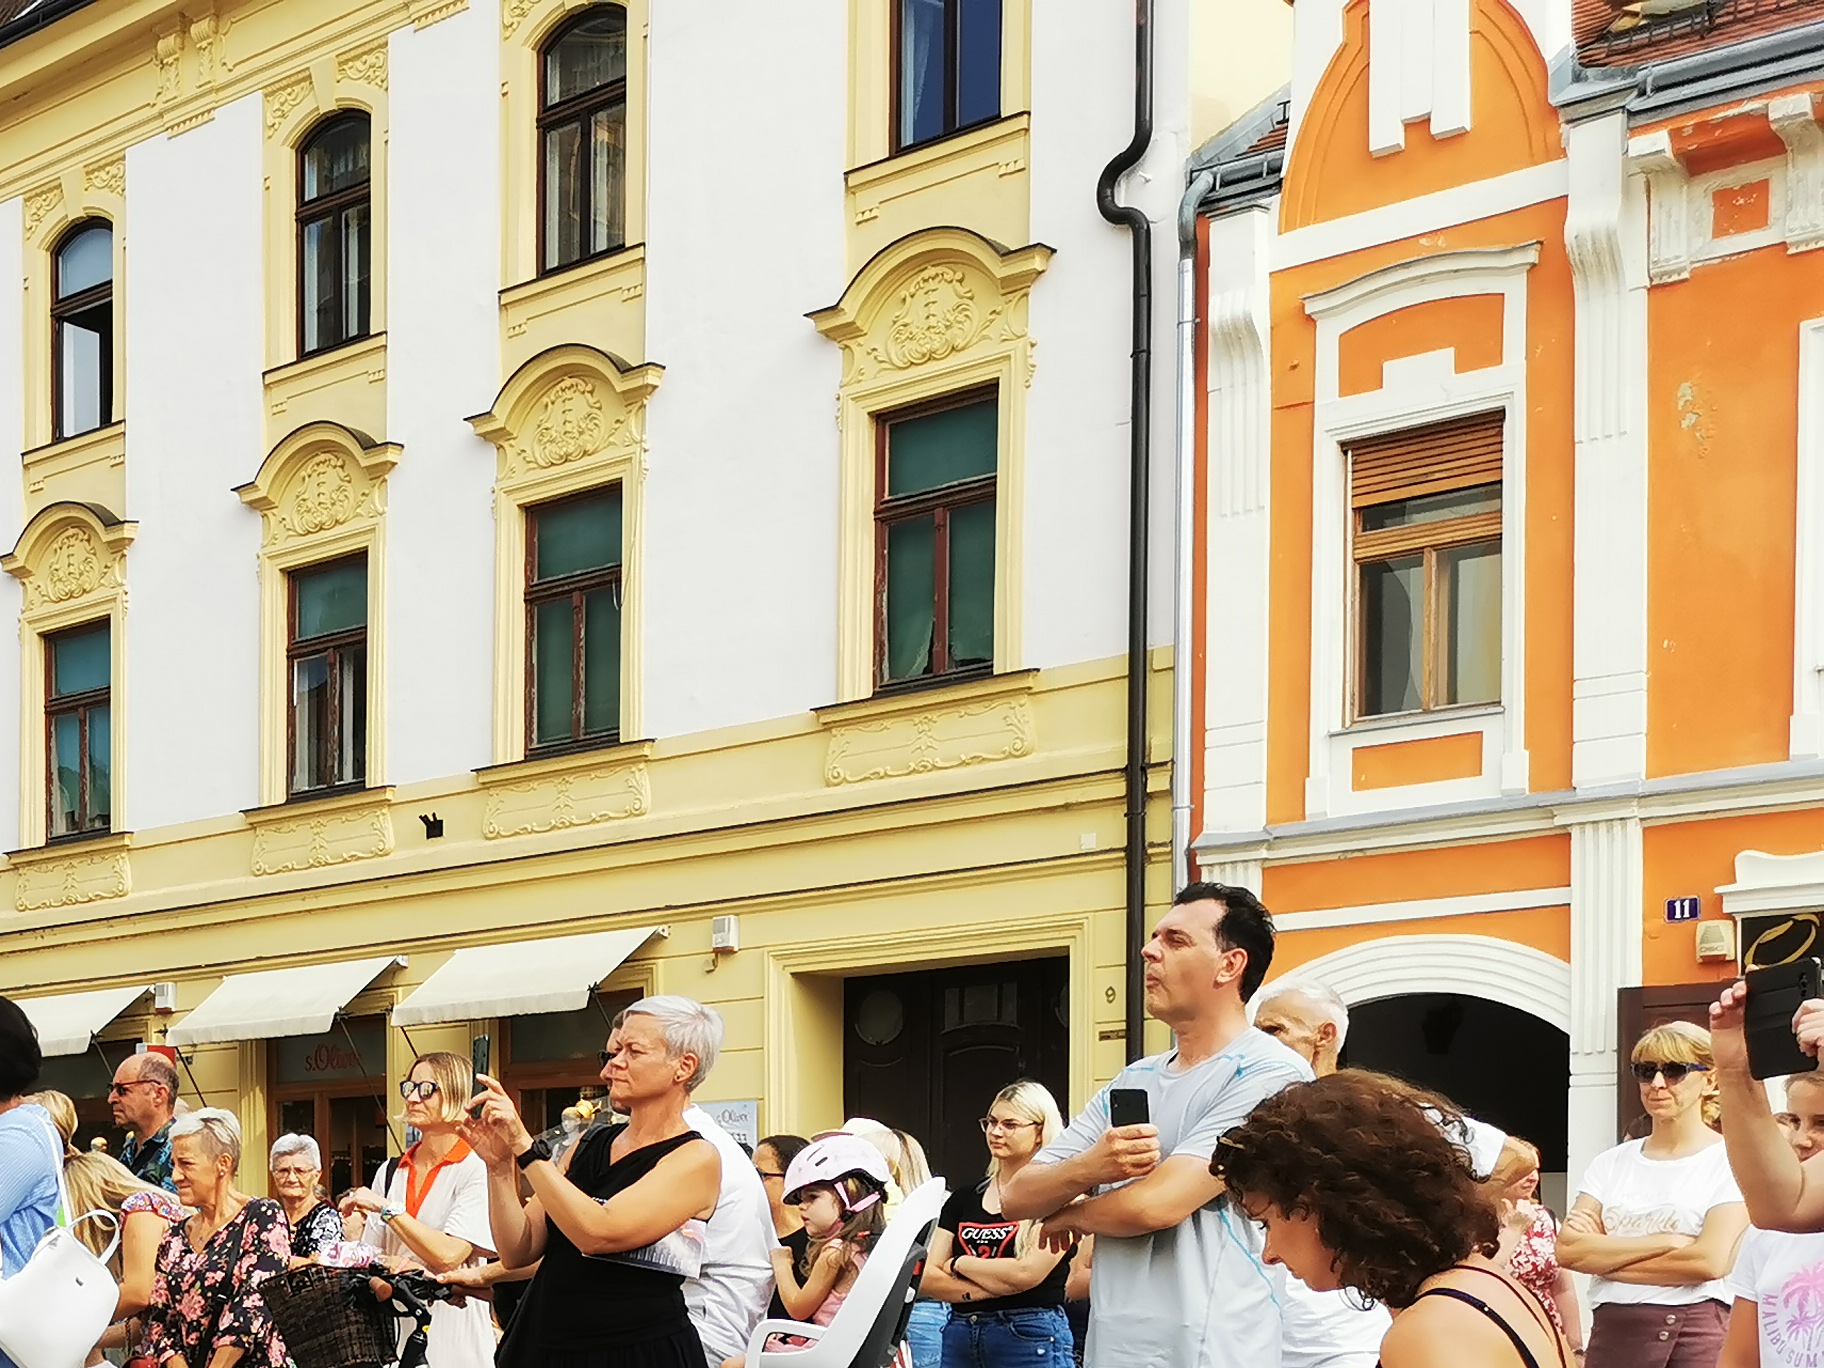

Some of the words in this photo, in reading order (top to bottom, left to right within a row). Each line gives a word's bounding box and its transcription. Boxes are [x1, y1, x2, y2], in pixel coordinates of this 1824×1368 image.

[1674, 899, 1691, 919] 11
[1105, 986, 1116, 1004] 9
[961, 1227, 1008, 1240] GUESS
[1762, 1292, 1788, 1355] MALIBU
